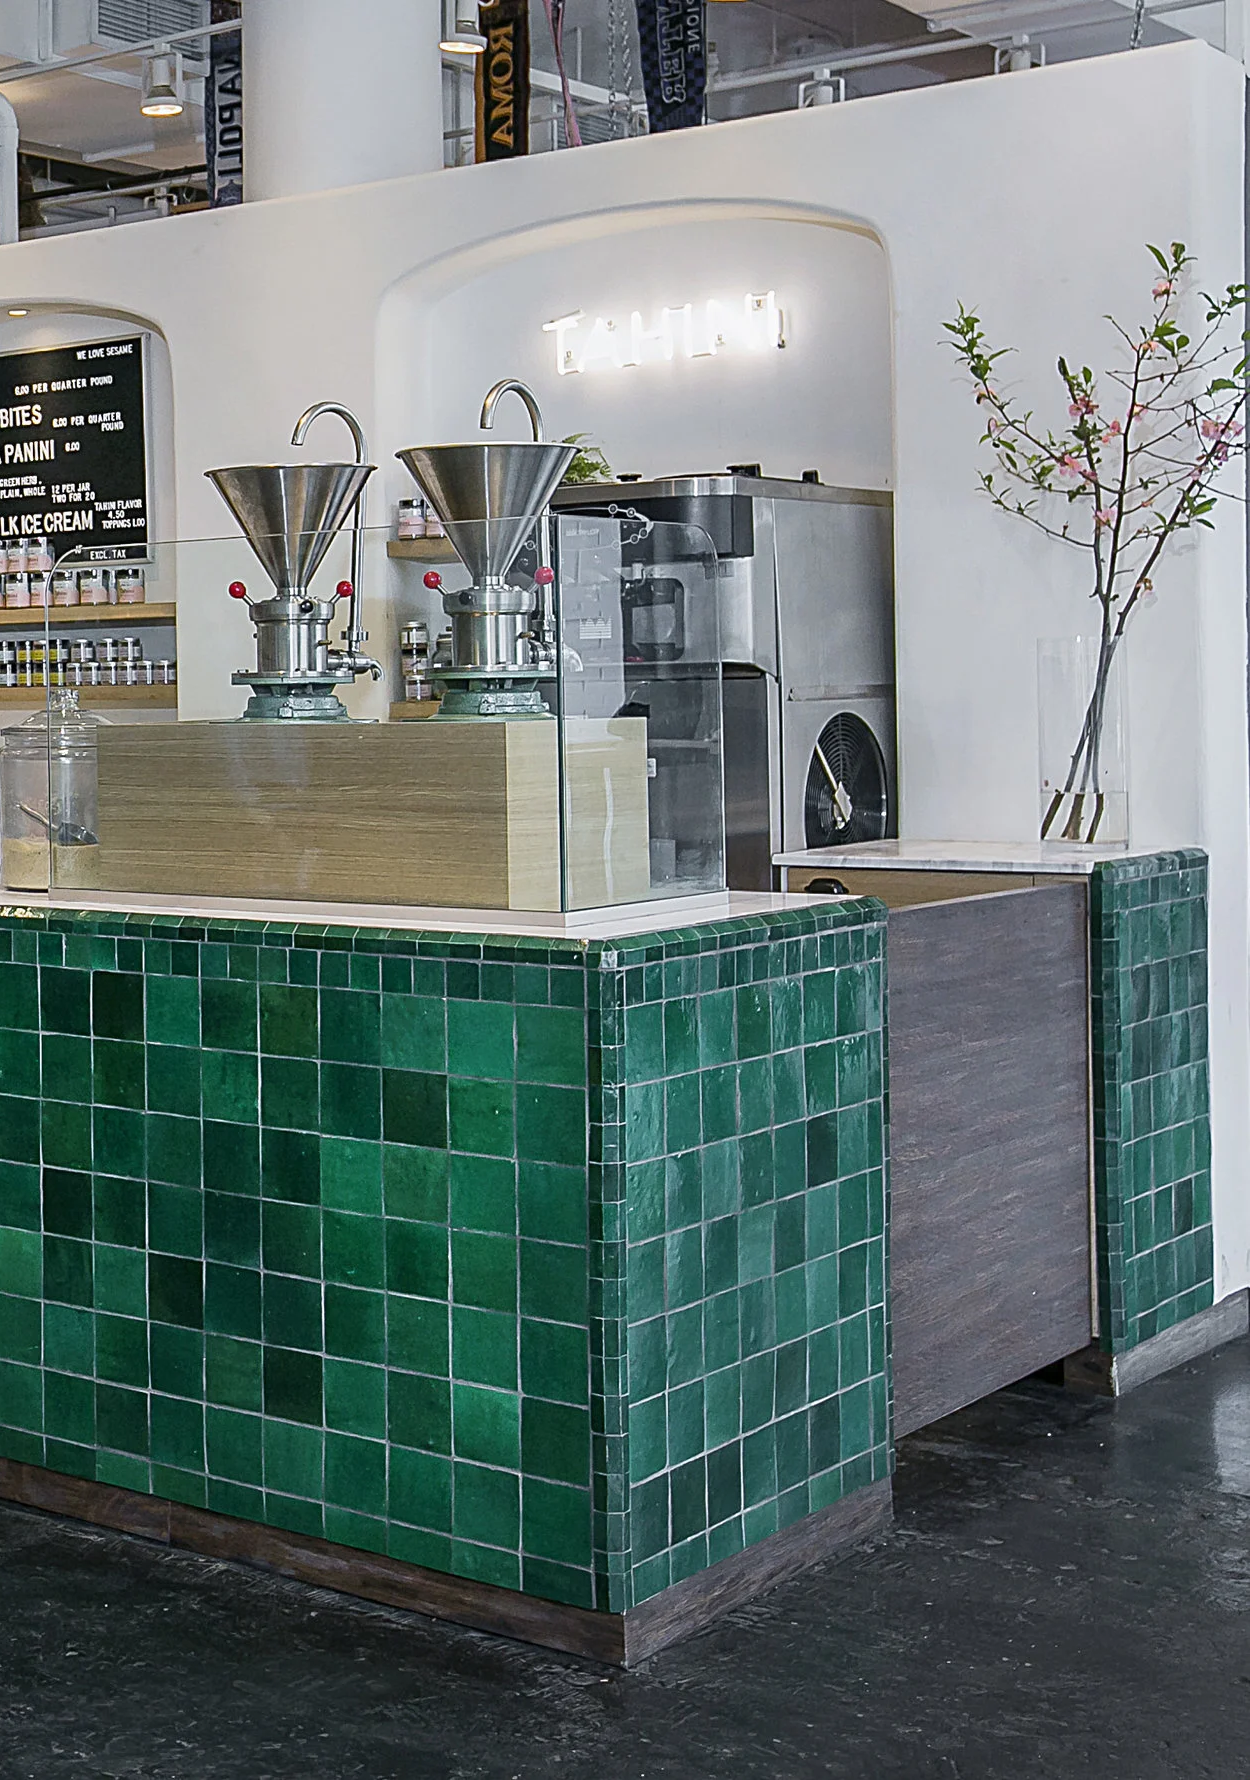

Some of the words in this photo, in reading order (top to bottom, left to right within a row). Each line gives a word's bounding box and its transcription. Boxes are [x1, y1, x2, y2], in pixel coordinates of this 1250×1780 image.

[76, 350, 87, 360] WE
[88, 348, 105, 359] LOVE
[106, 344, 133, 356] SESAME
[32, 382, 48, 394] PER
[51, 378, 87, 391] QUARTER
[90, 375, 113, 387] POUND
[70, 415, 85, 426] PER
[88, 411, 121, 424] QUARTER
[101, 420, 124, 432] POUND
[4, 439, 55, 465] PANINI
[23, 486, 46, 496] WHOLE
[51, 485, 60, 494] 12
[61, 484, 75, 493] PER
[77, 482, 91, 492] JAR
[51, 494, 66, 503] TWO
[69, 493, 82, 502] FOR
[85, 491, 95, 501] 20
[94, 500, 116, 511] TAHINI
[117, 499, 142, 510] FLAVOR
[107, 510, 125, 520] 4.50
[21, 513, 43, 535] ICE
[43, 510, 94, 533] CREAM
[102, 519, 131, 530] TOPPINGS
[112, 549, 127, 559] TAX
